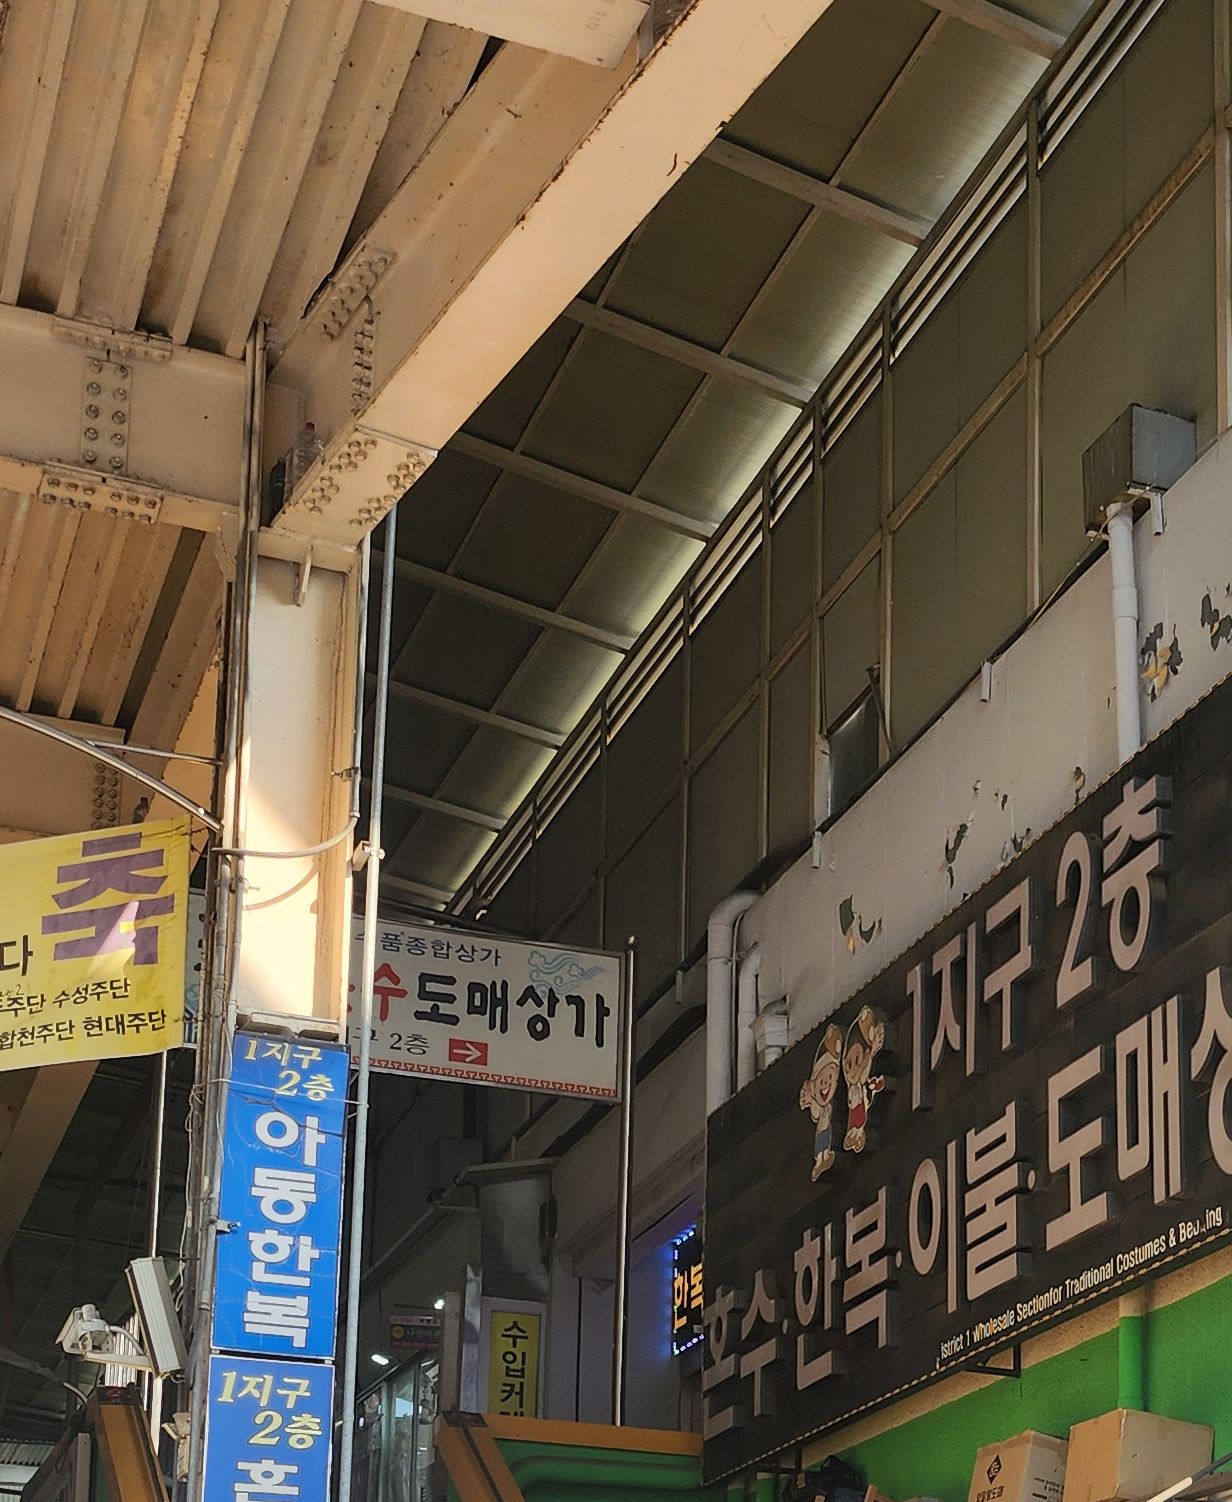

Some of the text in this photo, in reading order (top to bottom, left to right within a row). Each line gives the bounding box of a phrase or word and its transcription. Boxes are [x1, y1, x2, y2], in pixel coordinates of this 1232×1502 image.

[41, 832, 175, 966] 축
[354, 932, 502, 967] 품종합상가
[906, 776, 1171, 1110] 1지구 2층
[52, 977, 131, 1008] 수성주단
[83, 1009, 168, 1037] 현대주단
[244, 1039, 323, 1069] 1지구
[389, 1031, 431, 1056] 2층
[275, 1069, 335, 1102] 2층
[243, 1110, 327, 1349] 아동한복
[973, 1310, 1015, 1344] Wholesale
[1065, 1258, 1114, 1300] Traditional
[1116, 1238, 1167, 1275] Costumes
[1168, 1227, 1177, 1248] &
[500, 1321, 529, 1417] 수입커
[217, 1372, 311, 1410] 1지구
[246, 1410, 324, 1450] 2층
